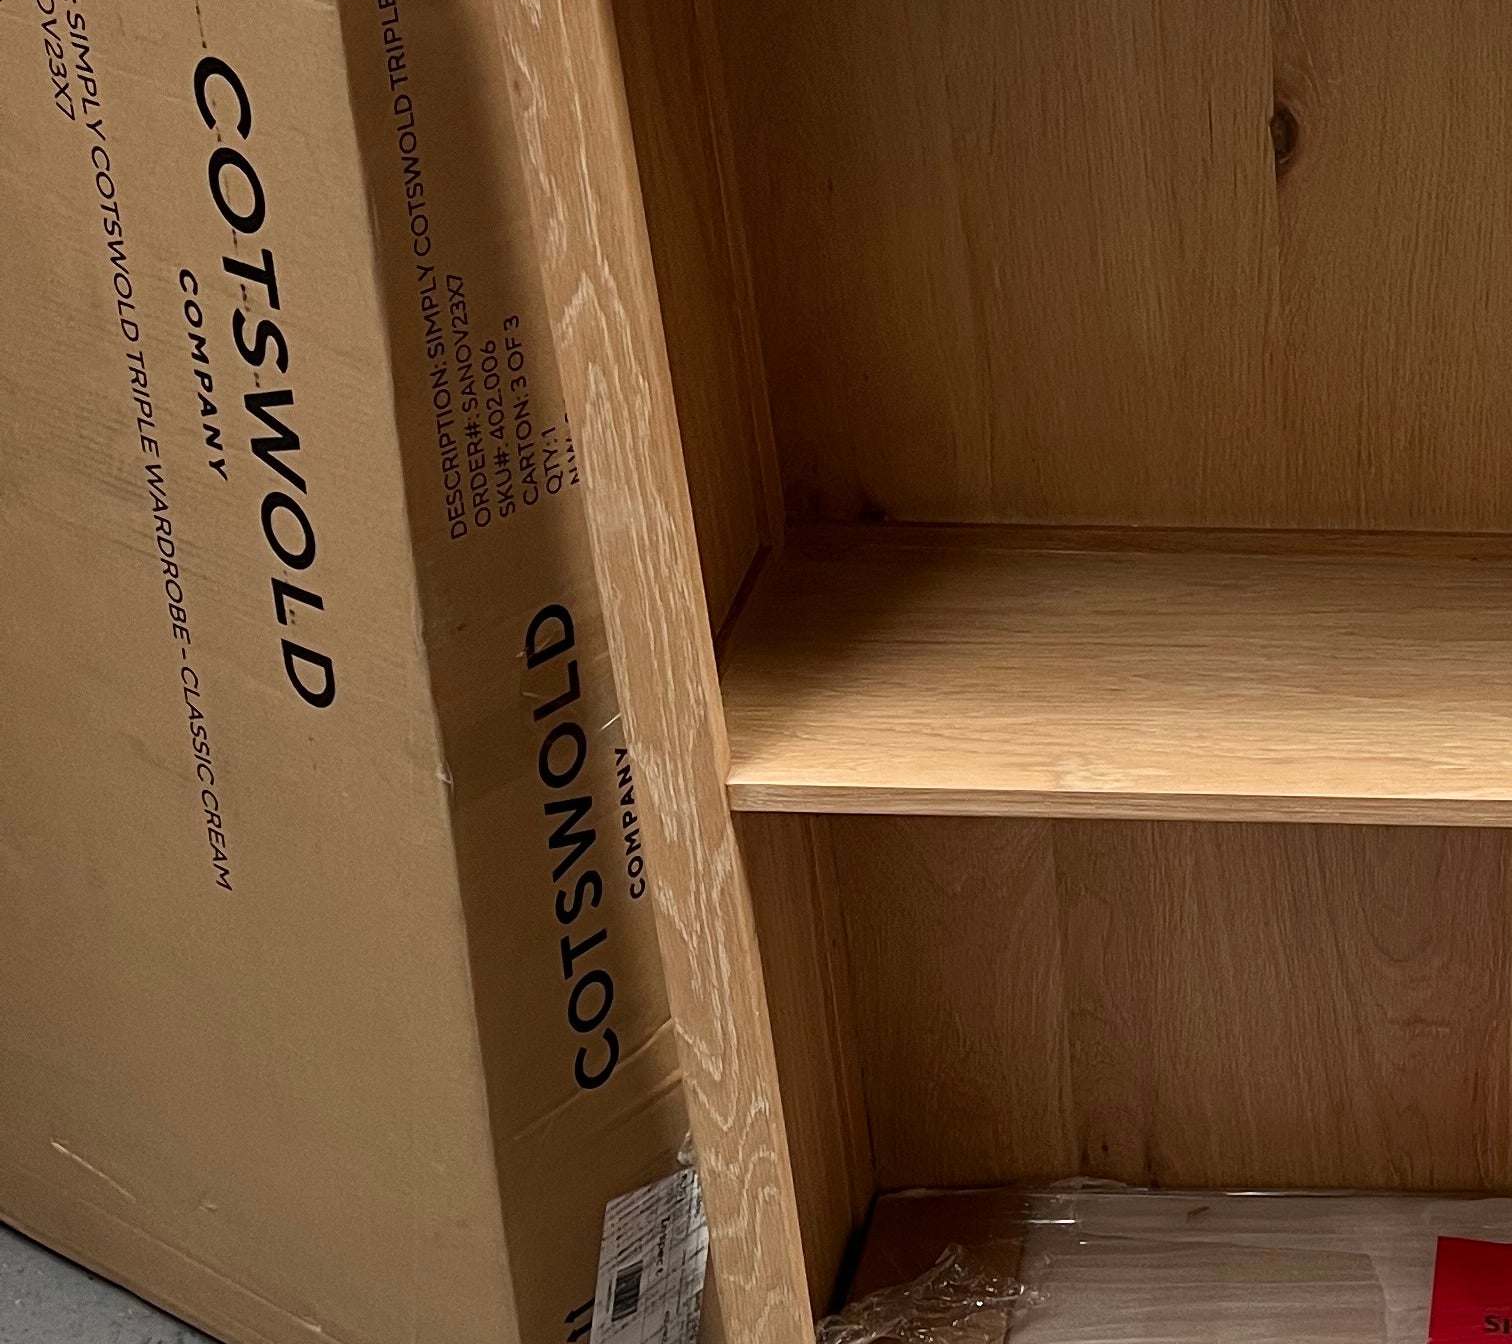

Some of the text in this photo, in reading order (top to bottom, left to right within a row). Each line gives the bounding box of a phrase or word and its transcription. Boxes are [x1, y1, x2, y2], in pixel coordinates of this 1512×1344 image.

[393, 94, 432, 257] COTSWOLD
[178, 267, 228, 482] COMPANY
[193, 56, 336, 709] COTSWOLD
[415, 263, 446, 359] SIMPLY
[445, 273, 492, 529] ORDER#: SANOV23X7
[503, 314, 540, 506] CARTON: 3 OF 3
[66, 10, 105, 141] SIMPLY
[91, 145, 139, 342] COTSWOLD
[125, 350, 160, 457] TRIPLE
[144, 463, 192, 644] WARDROBE
[181, 665, 215, 786] CLASSIC
[200, 788, 233, 892] CREAM
[429, 360, 468, 540] DESCRIPTION:
[524, 603, 620, 1091] COTSWOLD
[614, 747, 646, 901] COMPANY
